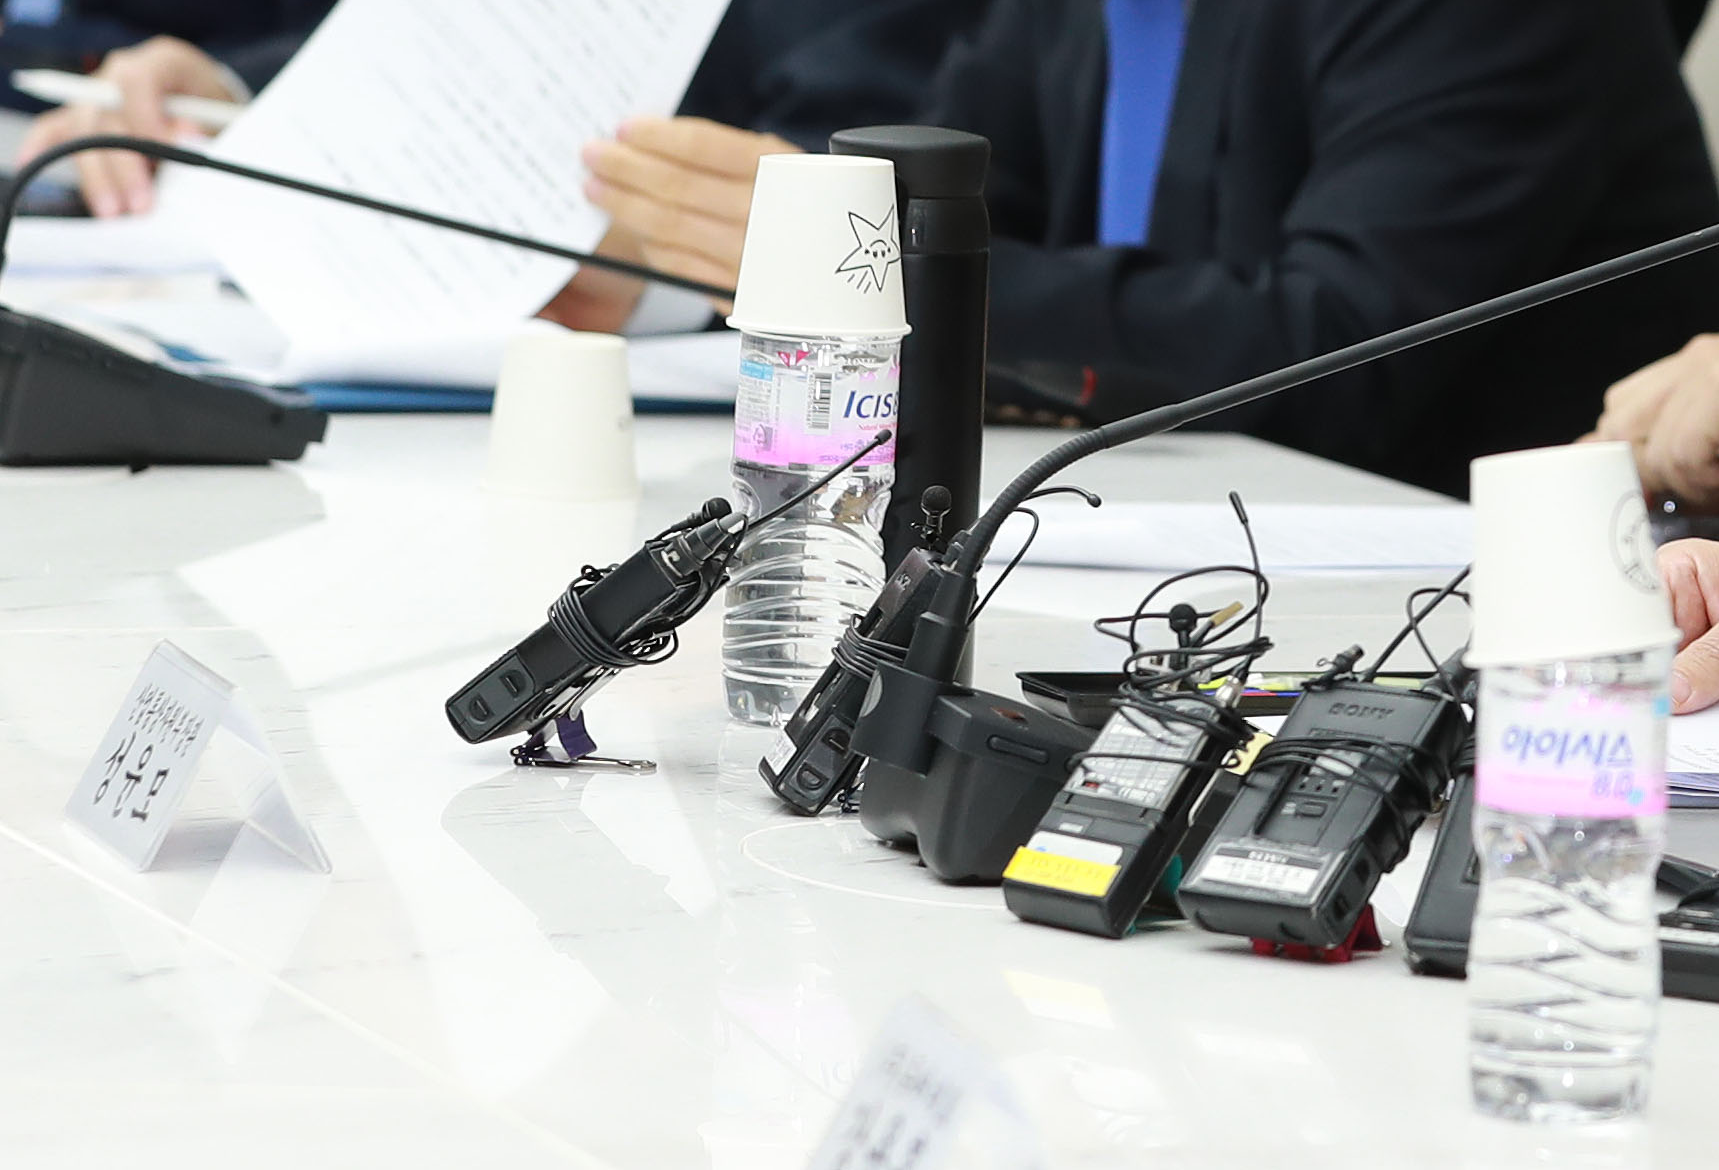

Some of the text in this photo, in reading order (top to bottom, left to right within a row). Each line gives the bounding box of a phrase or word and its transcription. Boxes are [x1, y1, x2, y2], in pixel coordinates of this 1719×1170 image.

[843, 390, 893, 419] ICIS
[1328, 702, 1395, 720] SONY
[1502, 725, 1634, 767] 아이시스
[92, 731, 170, 823] 성윤모
